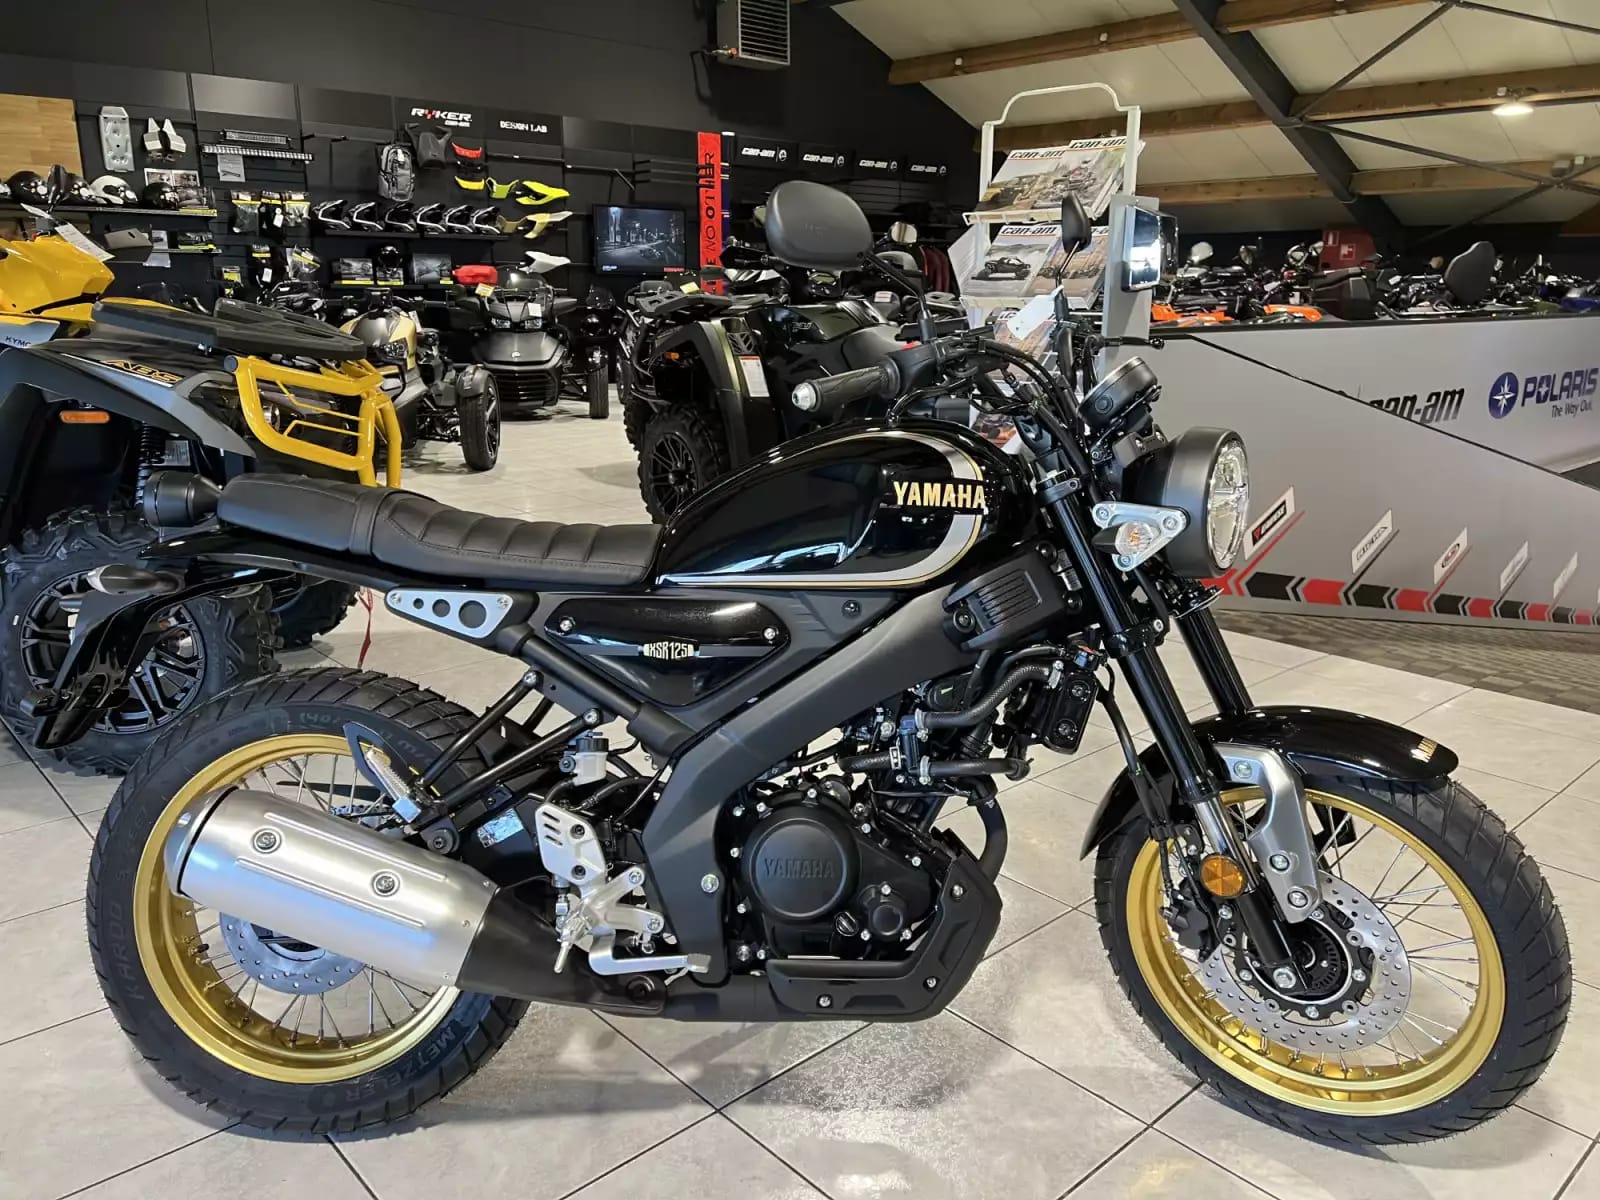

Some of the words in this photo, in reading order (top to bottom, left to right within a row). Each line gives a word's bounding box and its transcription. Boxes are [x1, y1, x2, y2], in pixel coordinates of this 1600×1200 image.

[410, 107, 472, 121] RYKER
[500, 120, 528, 131] DESIGN
[530, 124, 548, 133] LAB
[741, 147, 776, 158] can-am
[803, 153, 834, 164] can-am
[1010, 150, 1066, 159] can-am
[859, 159, 889, 169] can-am
[1001, 226, 1057, 235] can-am
[705, 225, 716, 252] NO
[1521, 367, 1599, 407] POLARIS
[892, 481, 986, 509] YAMAHA
[649, 641, 688, 660] XSR125
[763, 857, 834, 879] YAMAHA
[345, 1025, 456, 1101] METZELER
